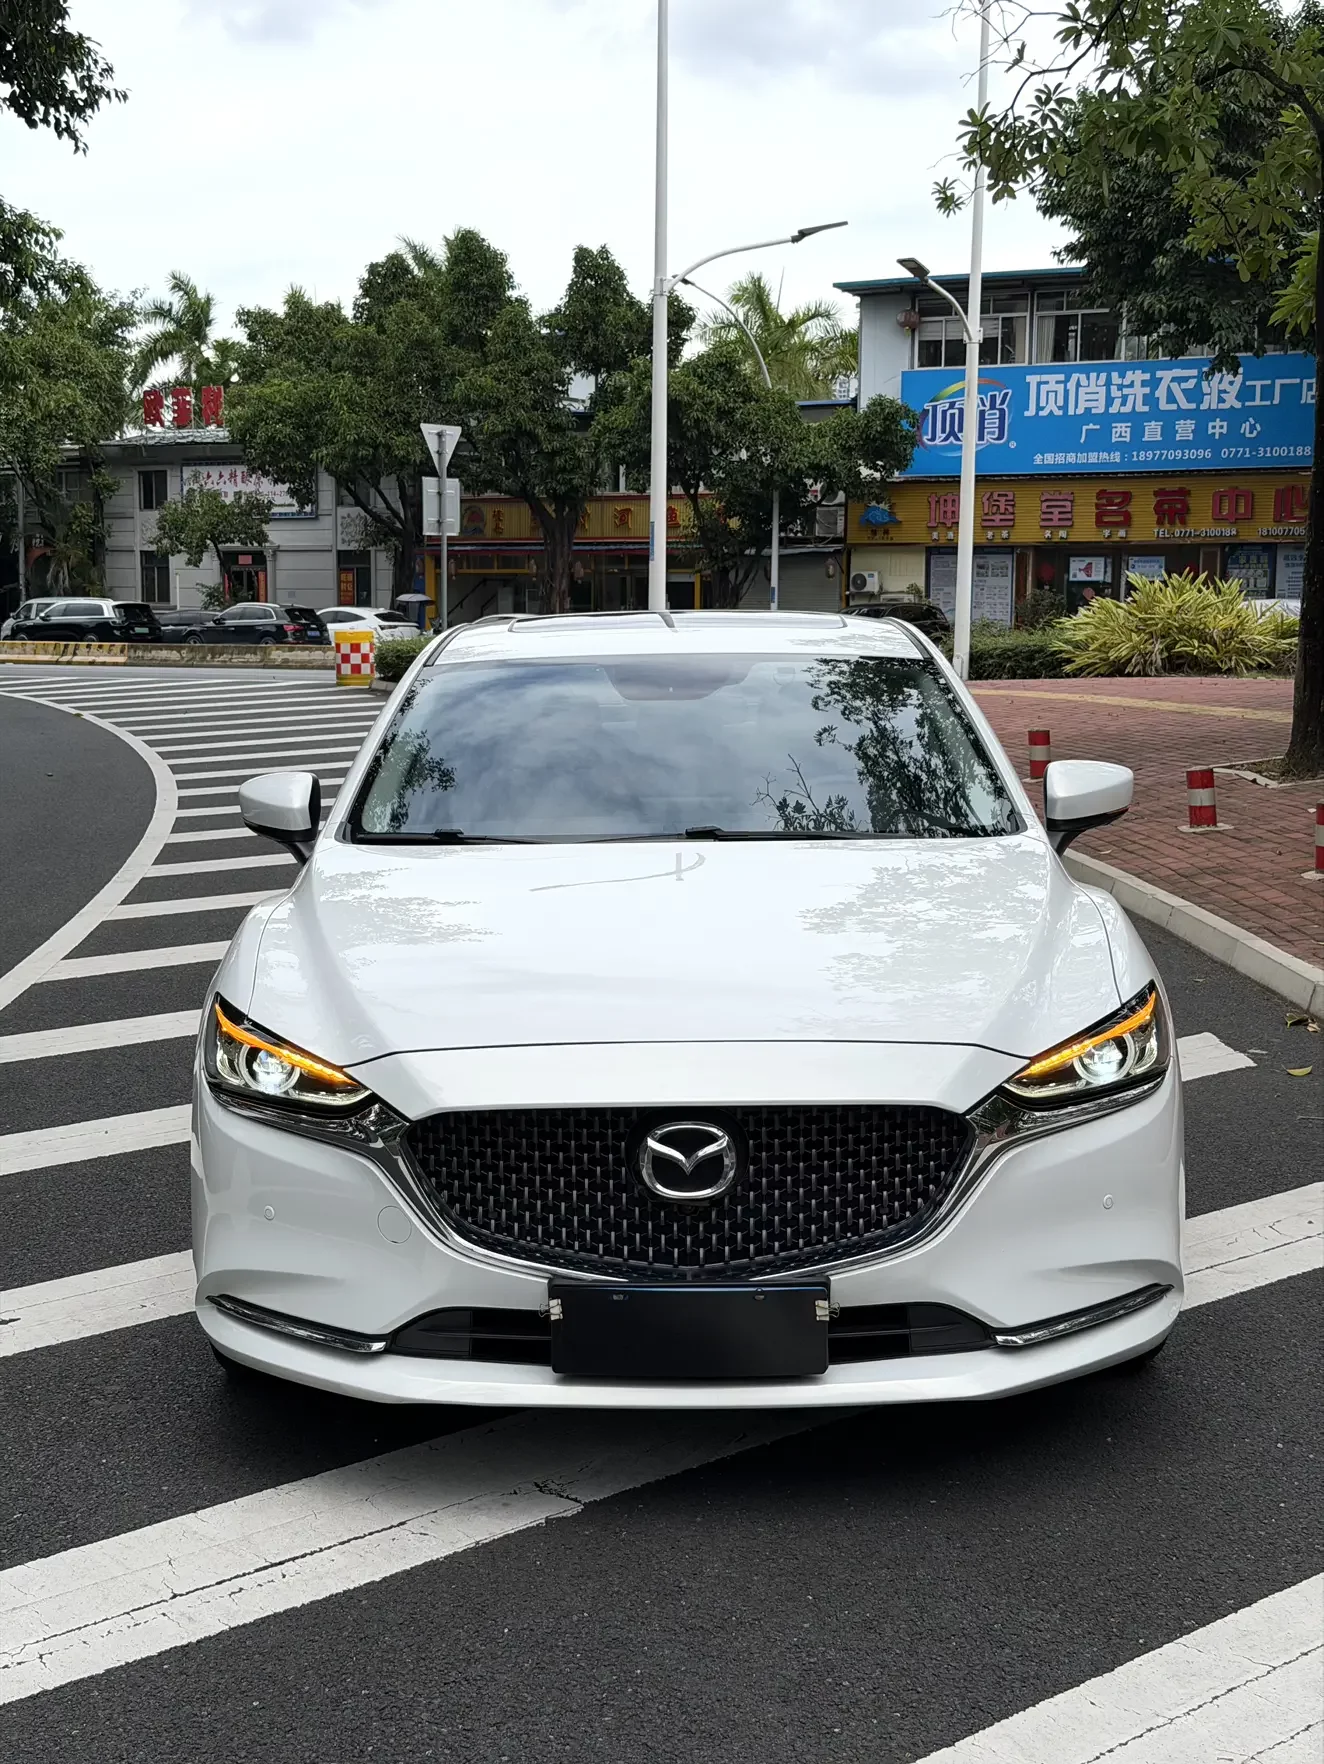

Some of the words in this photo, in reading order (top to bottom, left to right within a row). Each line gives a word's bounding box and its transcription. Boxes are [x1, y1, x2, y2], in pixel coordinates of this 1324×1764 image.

[1080, 417, 1261, 444] 广西直营中心
[1221, 446, 1311, 458] 0771-3100188
[926, 484, 1309, 528] 坤堡堂名茶中心
[1153, 527, 1237, 538] TEL:0771-3100188
[1258, 526, 1306, 536] 181007705
